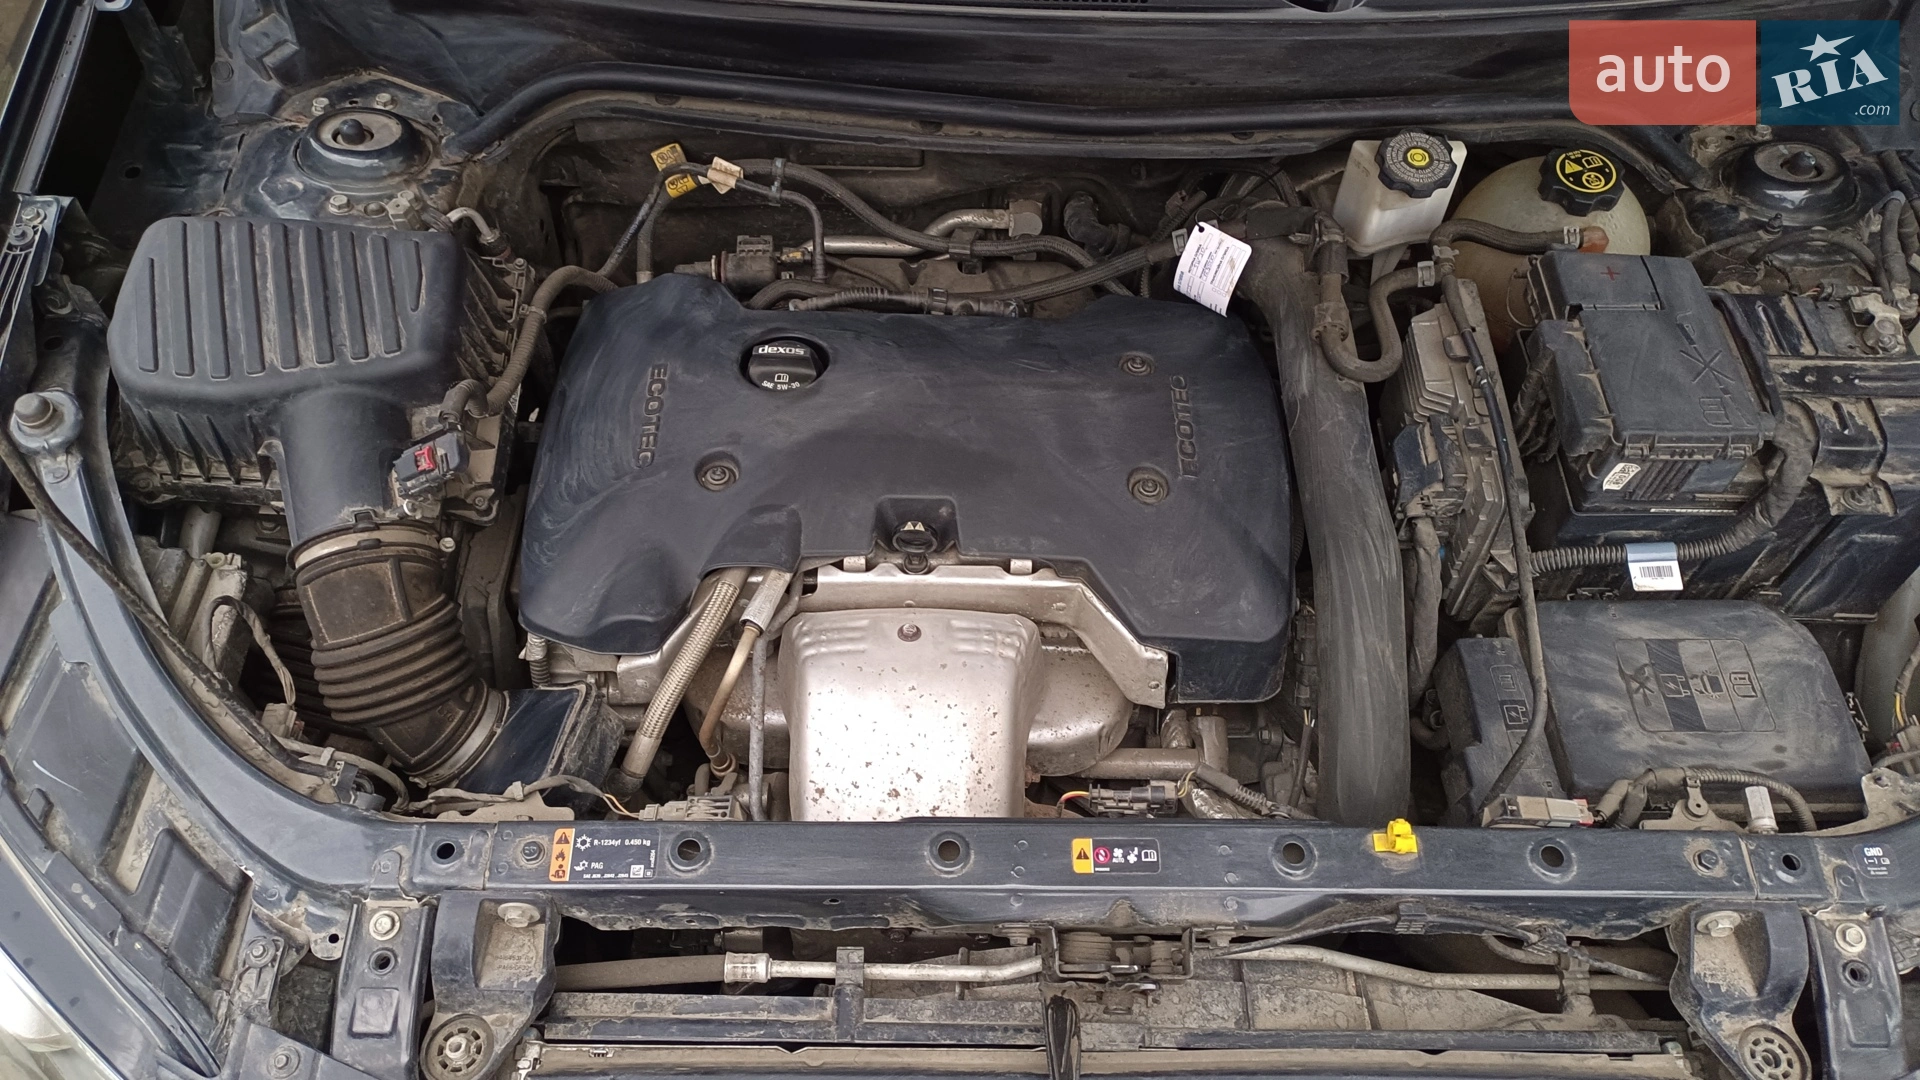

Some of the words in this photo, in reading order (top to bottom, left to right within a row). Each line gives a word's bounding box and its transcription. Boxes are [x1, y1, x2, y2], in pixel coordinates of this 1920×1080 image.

[758, 345, 807, 355] dexos
[761, 380, 775, 389] SAE
[777, 381, 801, 390] 5W-30
[636, 363, 668, 469] ECOTEC
[1170, 375, 1198, 478] ECOTEC
[593, 839, 621, 847] R-1234yf
[624, 838, 642, 846] 0.450
[642, 838, 651, 847] kg
[1863, 847, 1883, 856] GND
